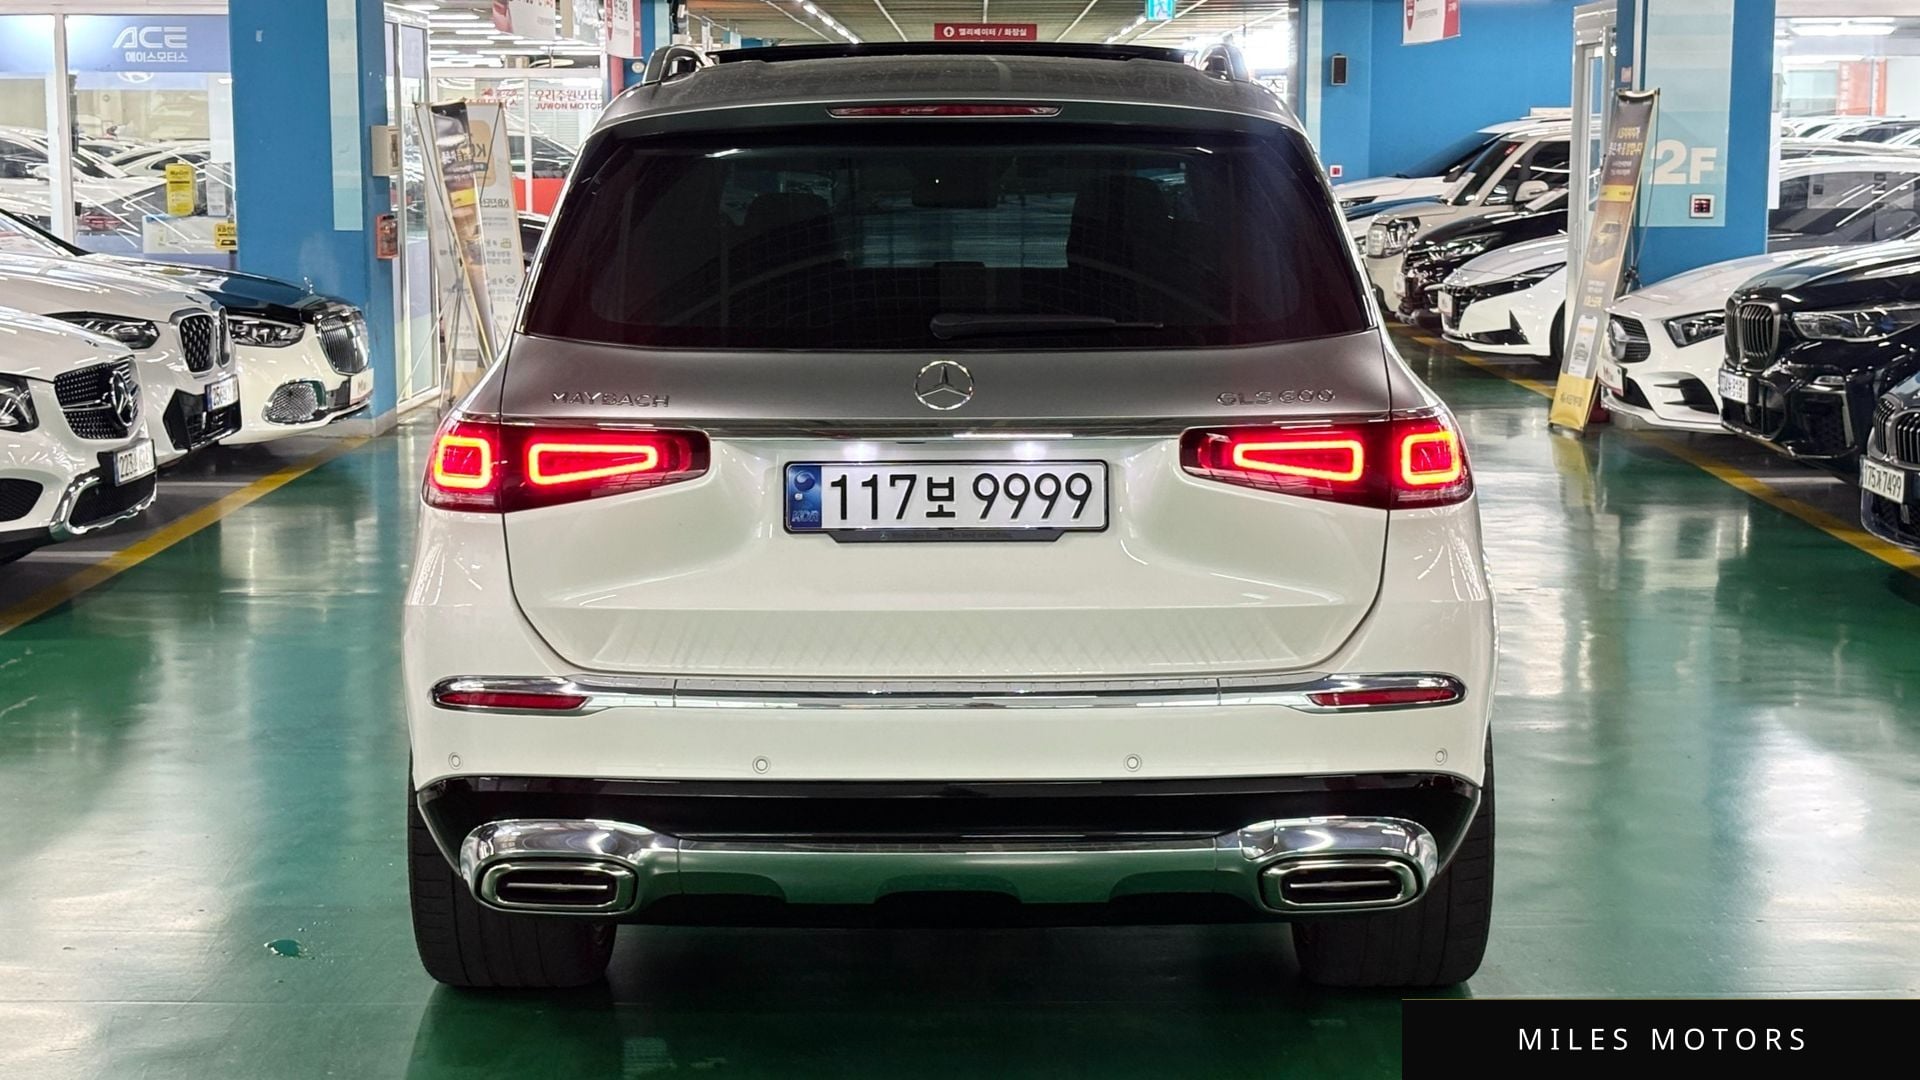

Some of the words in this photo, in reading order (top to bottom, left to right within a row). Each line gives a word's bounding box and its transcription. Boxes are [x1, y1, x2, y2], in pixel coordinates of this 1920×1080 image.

[112, 26, 188, 49] ACE
[959, 28, 996, 36] 엘리베이터
[1004, 28, 1028, 36] 화장실
[125, 51, 189, 63] 에이스모터스
[535, 89, 603, 101] 우리주원모터
[535, 102, 568, 110] JUWON
[1648, 139, 1717, 185] 2F
[551, 391, 670, 407] MAYBACH
[1216, 391, 1272, 406] GLS
[1279, 389, 1336, 404] 600
[831, 474, 956, 520] 117보
[972, 473, 1093, 520] 9999
